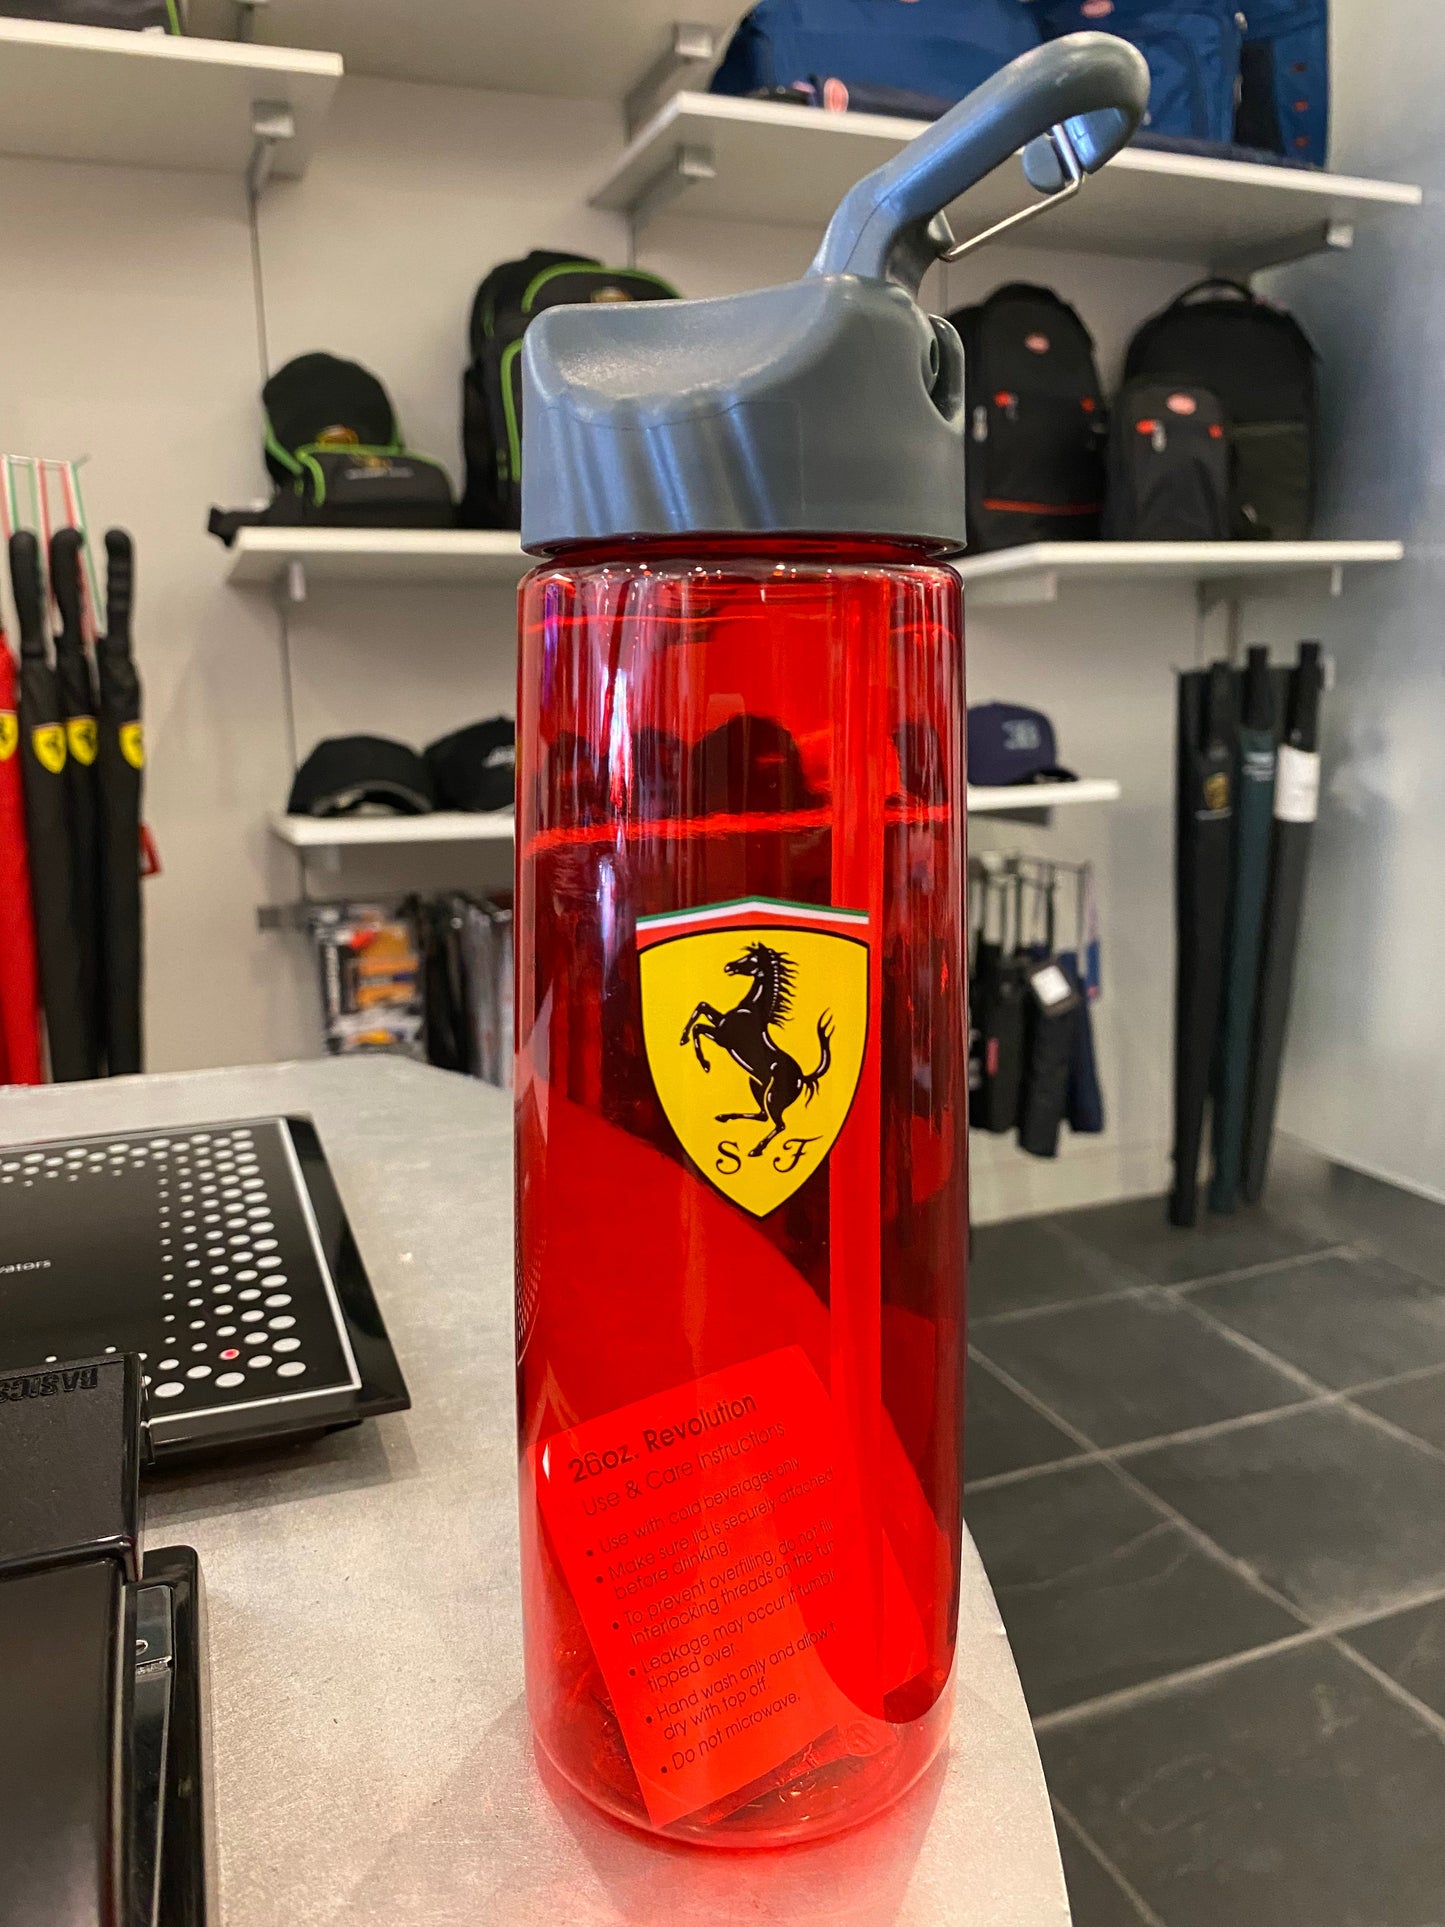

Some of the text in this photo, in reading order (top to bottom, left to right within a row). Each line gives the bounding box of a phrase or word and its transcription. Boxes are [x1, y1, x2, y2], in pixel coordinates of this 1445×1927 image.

[715, 1134, 825, 1175] S F
[569, 1395, 757, 1483] 26oz. Revolution
[582, 1422, 785, 1516] Use & Care Instructions
[599, 1457, 799, 1553] Use with cold beverages only
[608, 1553, 655, 1580] Make
[659, 1537, 689, 1560] sure
[691, 1525, 710, 1545] lid
[723, 1497, 776, 1531] securely
[778, 1466, 833, 1504] attached
[614, 1569, 668, 1600] before
[624, 1610, 643, 1627] To
[647, 1578, 706, 1621] prevent
[709, 1550, 776, 1589] overfilling,
[778, 1539, 797, 1556] do
[798, 1525, 818, 1545] not
[629, 1598, 719, 1647] interlocking
[721, 1569, 773, 1605] threads
[775, 1561, 793, 1580] on
[793, 1550, 813, 1570] the
[641, 1634, 710, 1675] Leakage
[713, 1616, 744, 1641] may
[747, 1594, 786, 1624] occur
[786, 1586, 797, 1605] if
[647, 1656, 700, 1693] tipped
[656, 1690, 699, 1721] Hand
[701, 1672, 739, 1699] wash
[739, 1657, 766, 1681] only
[768, 1643, 795, 1666] and
[796, 1628, 828, 1652] allow
[663, 1720, 688, 1740] dry
[690, 1700, 721, 1727] with
[722, 1690, 747, 1711] top
[671, 1691, 801, 1771] Do not microwave.
